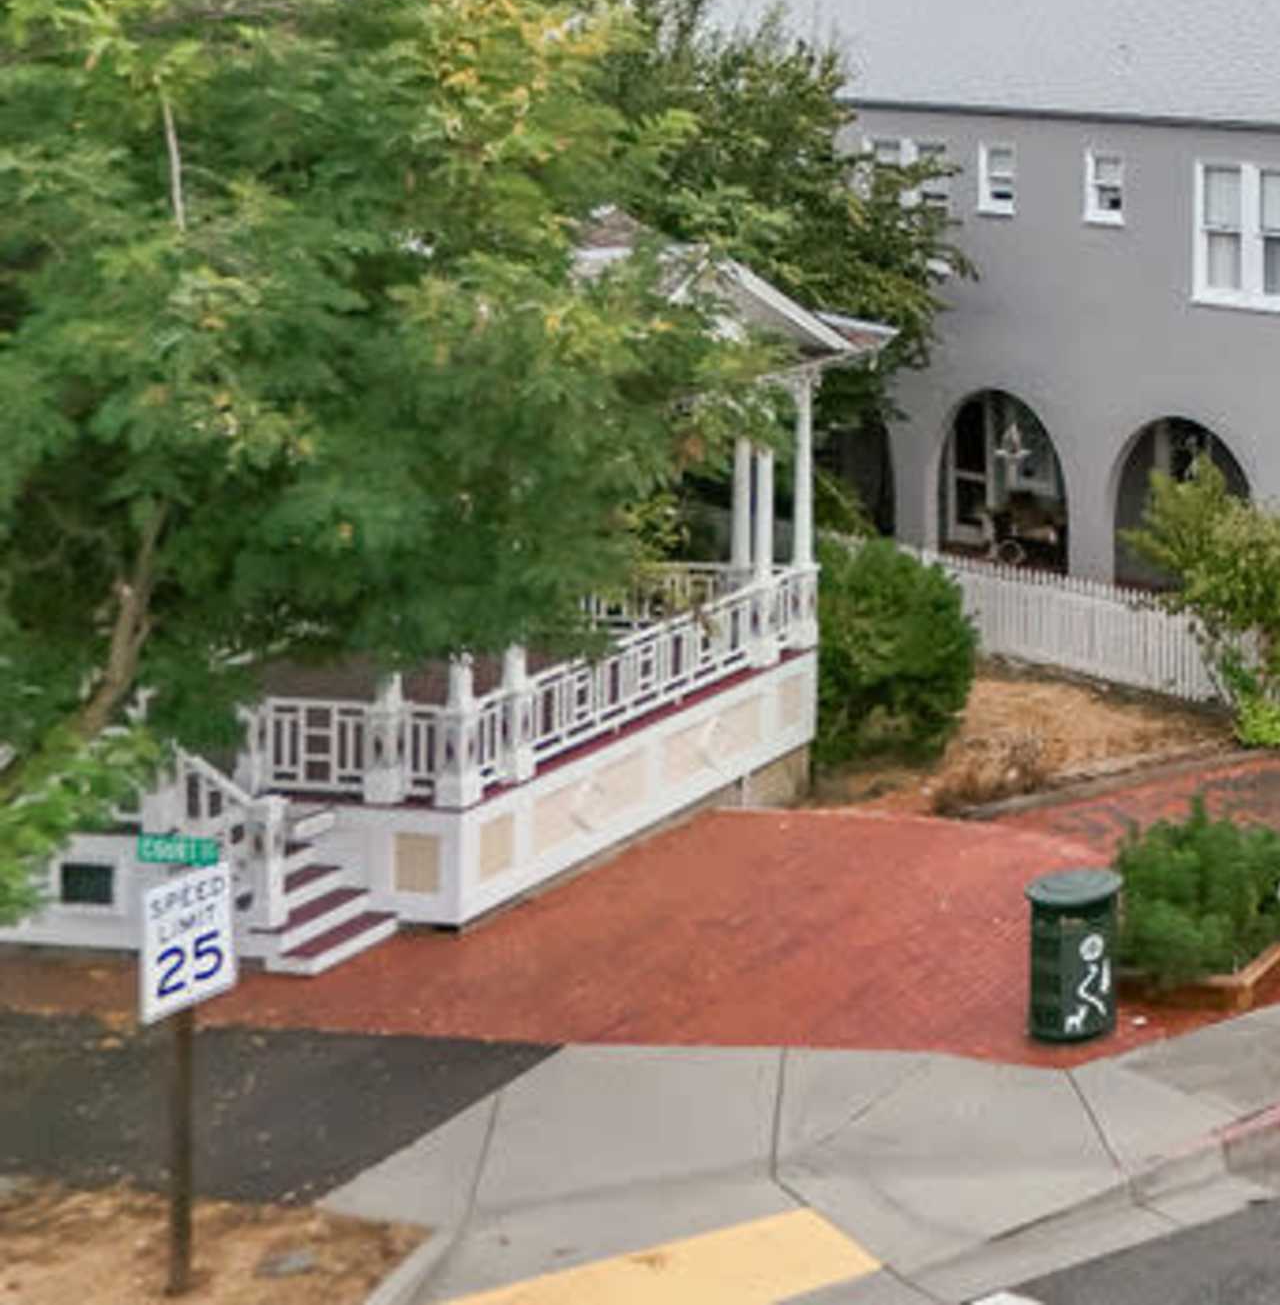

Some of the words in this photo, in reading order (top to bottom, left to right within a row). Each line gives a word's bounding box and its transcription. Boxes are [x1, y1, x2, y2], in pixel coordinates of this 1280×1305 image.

[150, 876, 225, 920] SPEED
[158, 903, 216, 944] LIMIT
[157, 930, 223, 996] 25
